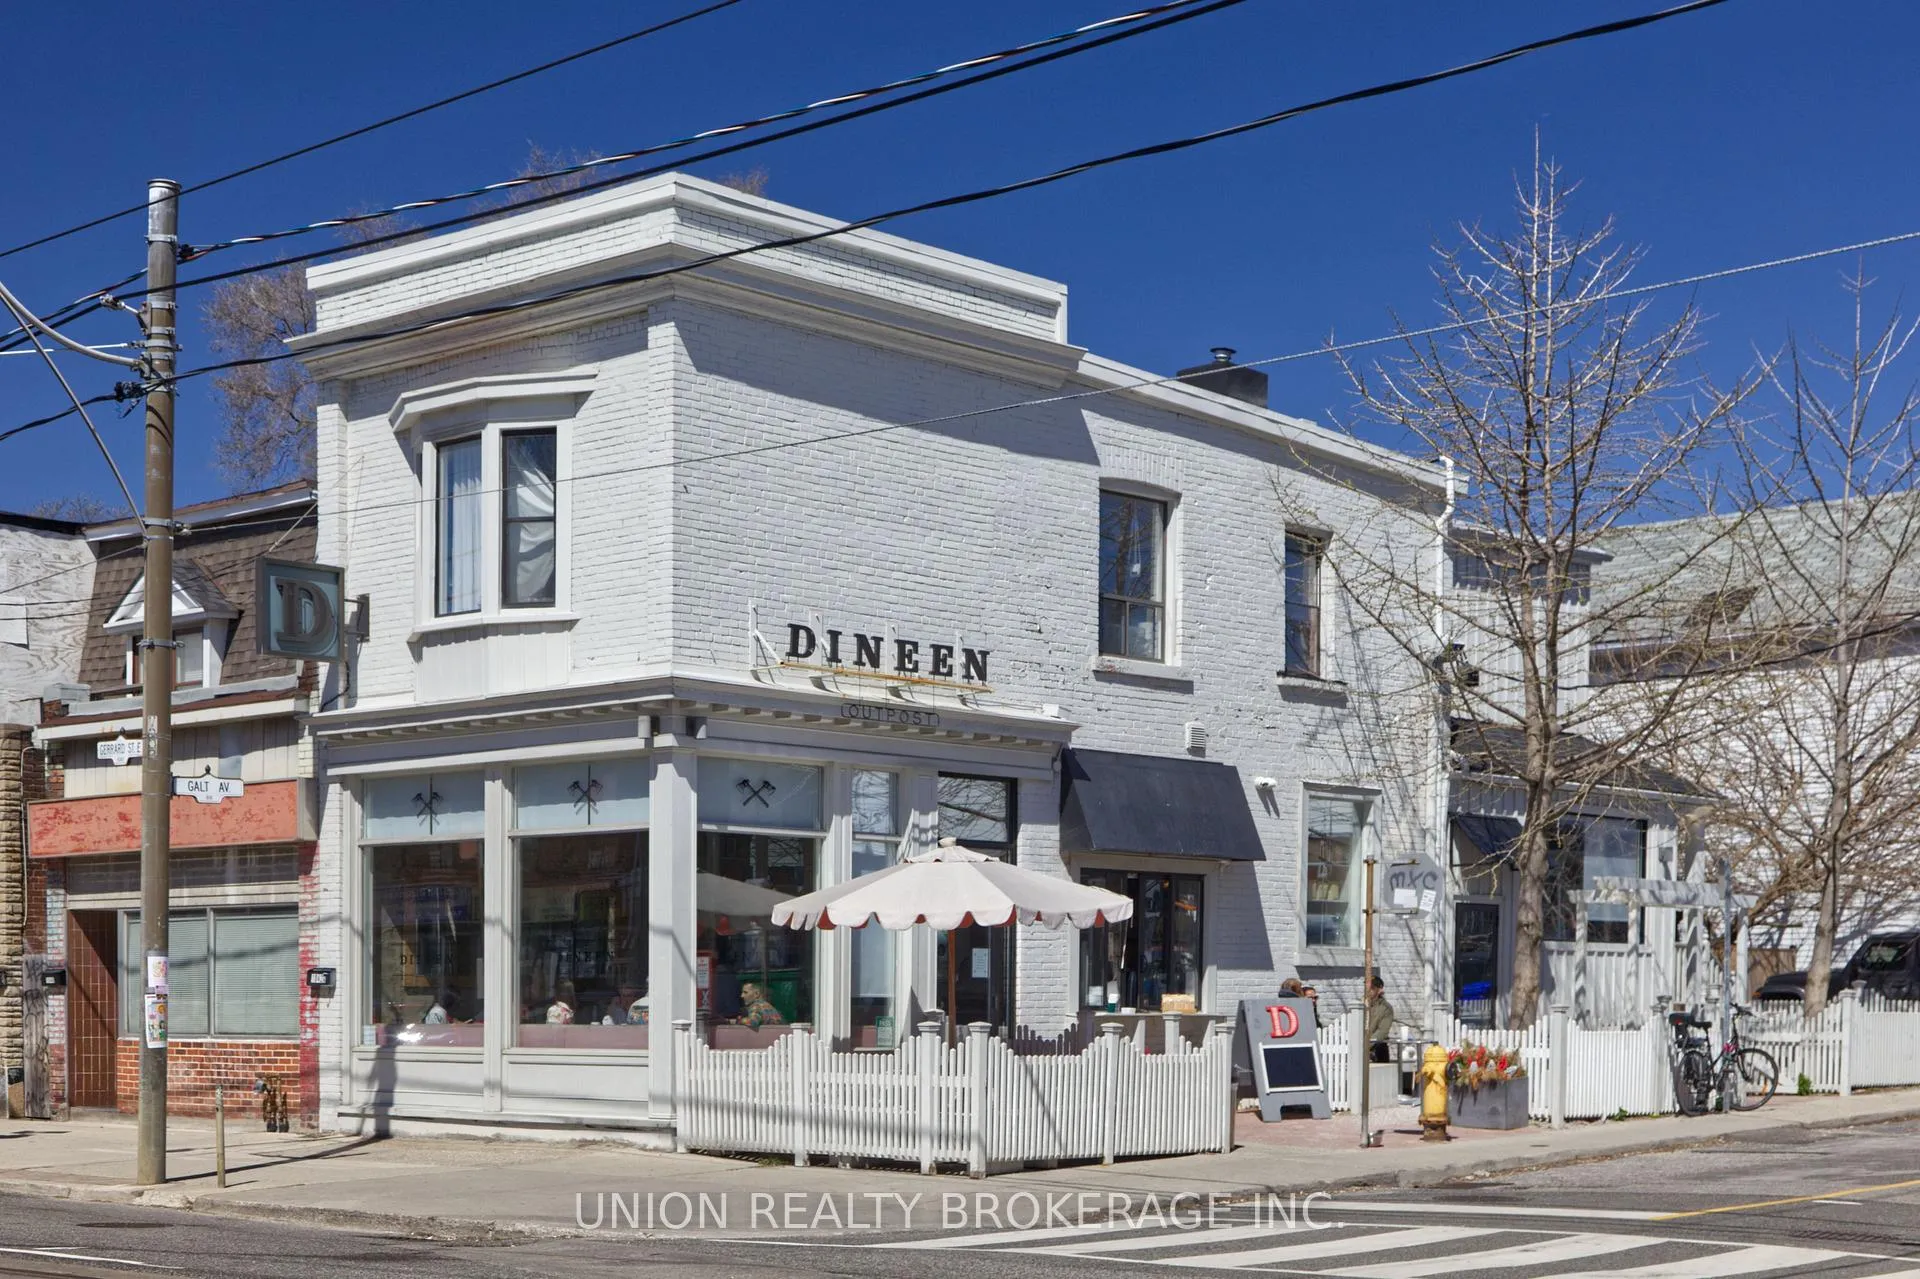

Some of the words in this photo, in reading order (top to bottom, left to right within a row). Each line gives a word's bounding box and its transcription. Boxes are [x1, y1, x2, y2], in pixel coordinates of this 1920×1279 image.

[275, 577, 335, 645] D
[785, 623, 990, 682] DINEEN
[849, 704, 934, 725] OUTPOST
[187, 780, 209, 792] GALT
[1265, 1005, 1299, 1038] D
